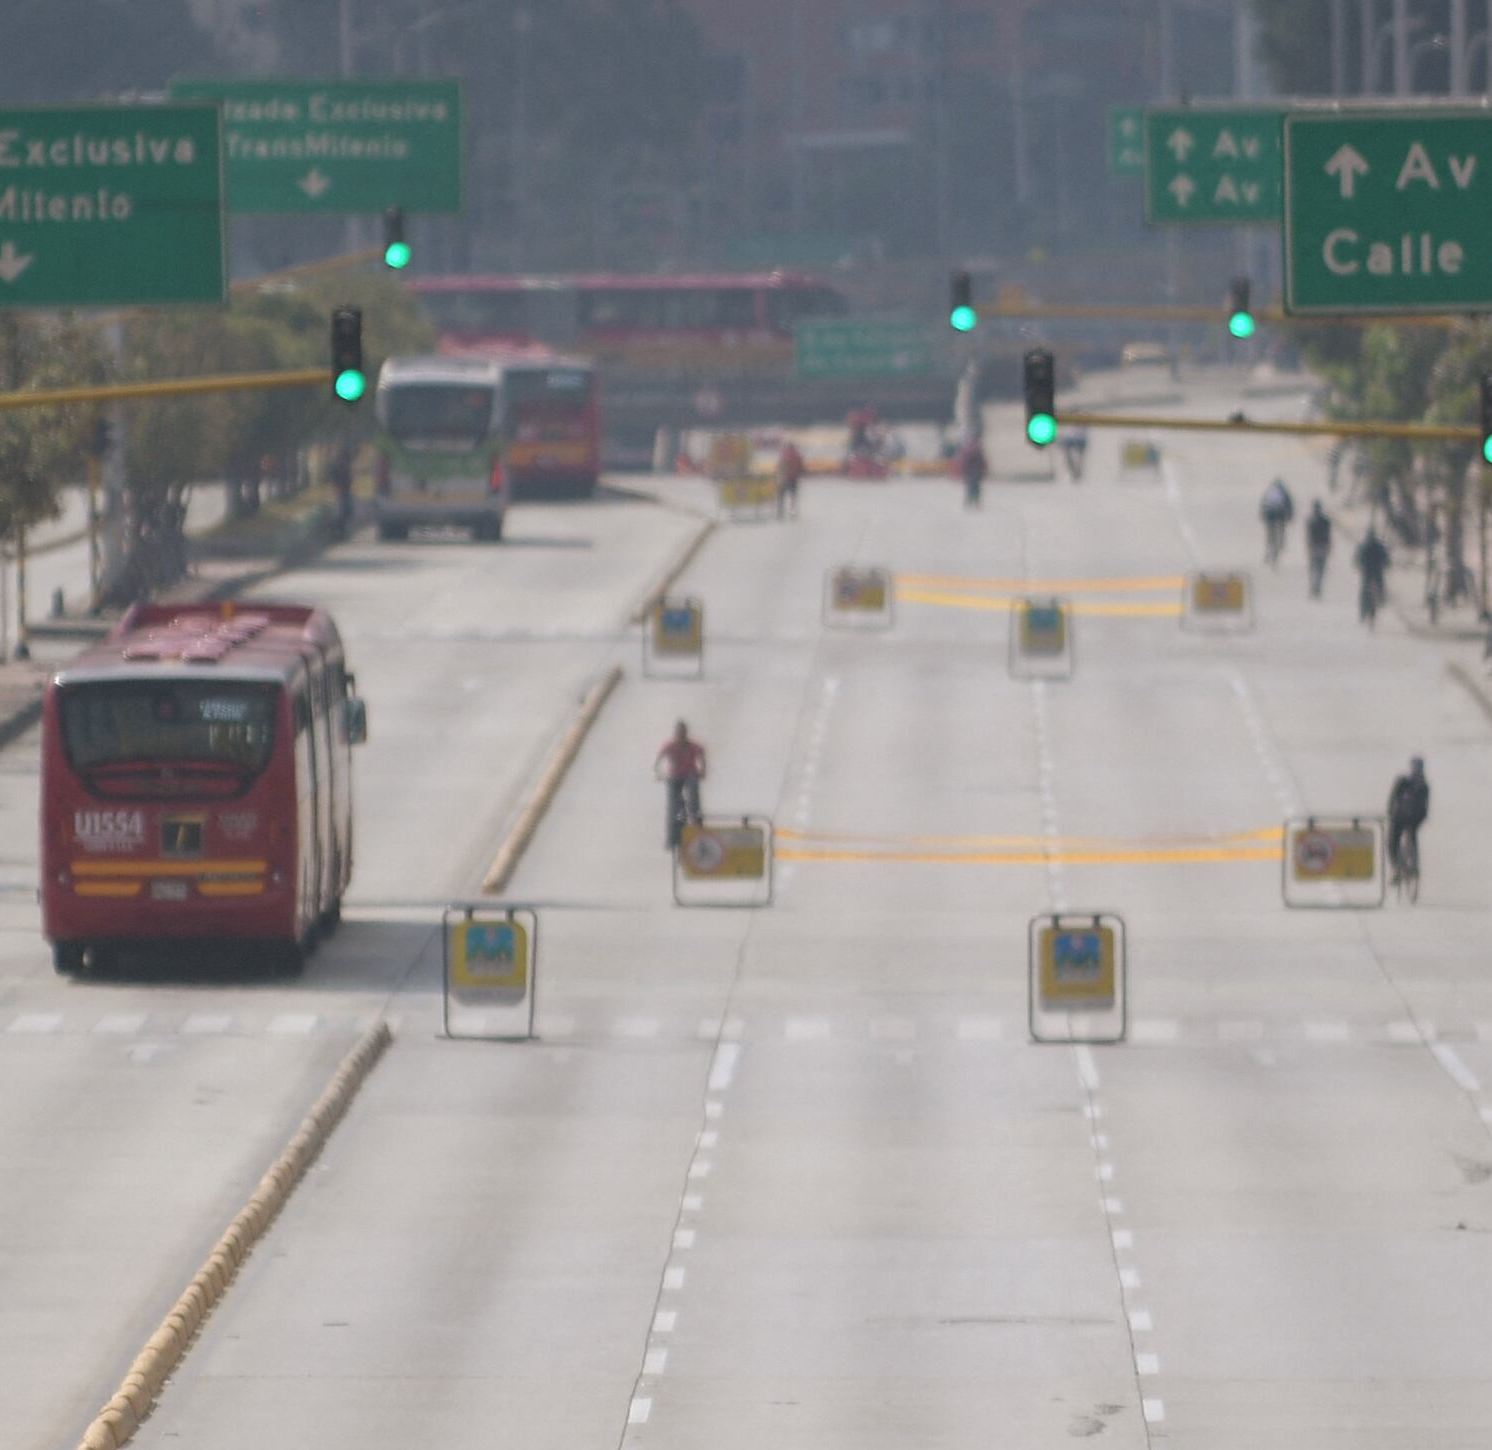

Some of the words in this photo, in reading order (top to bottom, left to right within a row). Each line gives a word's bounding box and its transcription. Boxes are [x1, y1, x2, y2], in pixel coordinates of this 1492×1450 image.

[222, 99, 299, 122] lzada
[309, 94, 447, 122] Exclusiva
[227, 132, 408, 159] TransMilenio
[1212, 129, 1259, 159] Av
[1395, 141, 1477, 190] Av
[1212, 174, 1258, 204] Av
[1322, 227, 1465, 276] Calle
